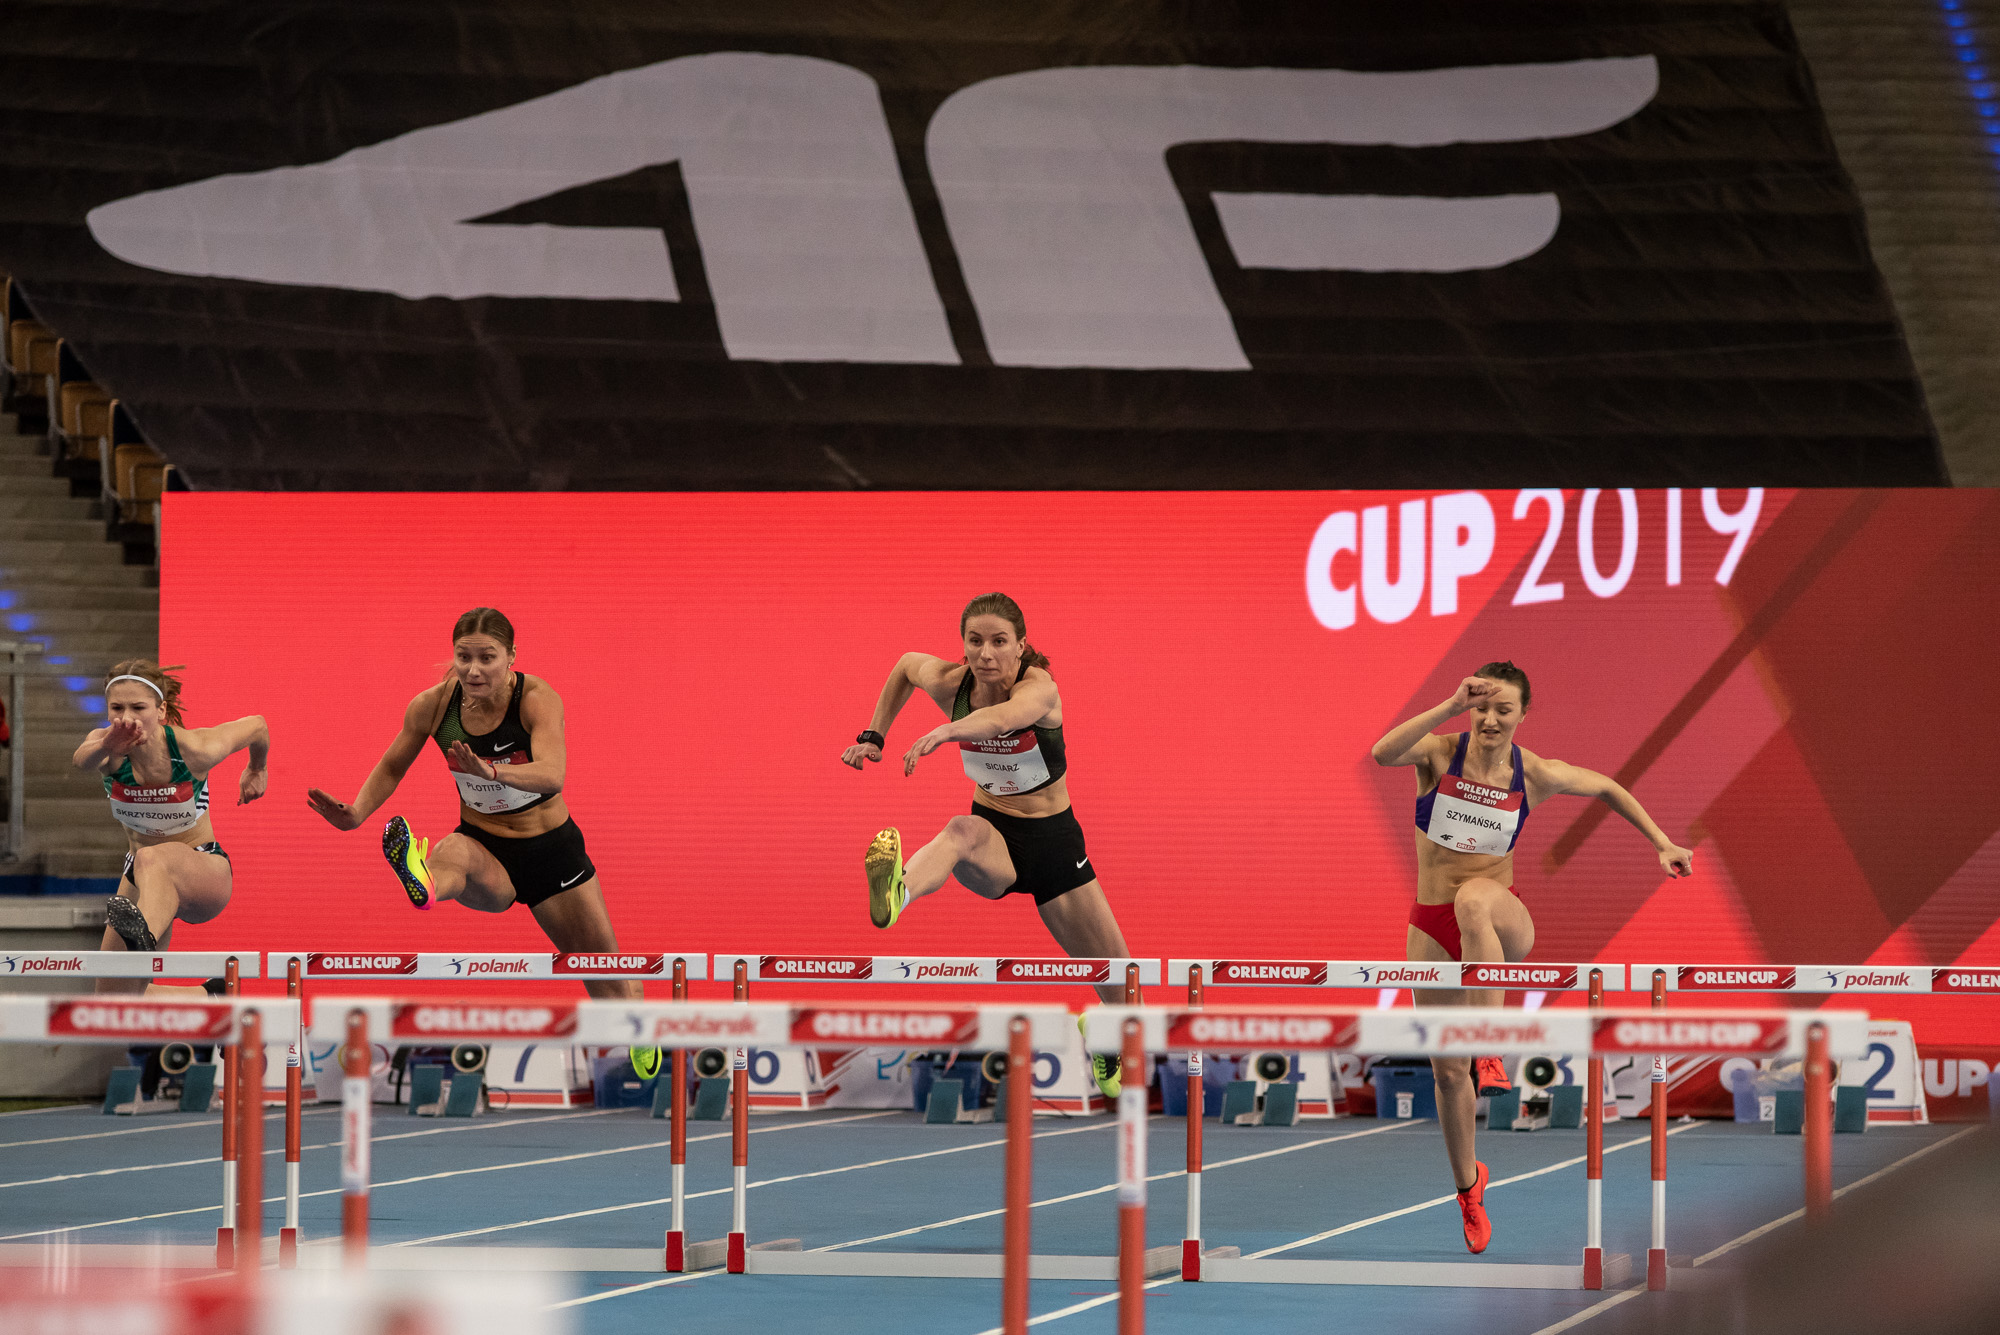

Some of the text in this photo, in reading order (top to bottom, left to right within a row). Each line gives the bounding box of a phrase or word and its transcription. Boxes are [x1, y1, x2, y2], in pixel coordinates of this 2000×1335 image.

[1305, 487, 1764, 630] CUP 2019
[985, 763, 1020, 772] SICIARZ
[124, 786, 177, 797] ORLEN CUP
[1456, 781, 1509, 800] ORLEN CUP
[1482, 797, 1498, 806] 2019
[116, 808, 192, 820] SKRZYSZOWSKA
[1446, 810, 1502, 831] SZYMAŃSKA
[21, 957, 83, 974] polanik
[322, 956, 401, 970] ORLEN CUP
[467, 958, 529, 977] polanik
[567, 956, 647, 969] ORLEN CUP
[775, 960, 856, 974] ORLEN CUP
[916, 962, 979, 980] polanik
[1012, 963, 1093, 977] ORLEN CUP
[1228, 965, 1310, 979] ORLEN CUP
[1376, 966, 1441, 984] polanik
[1477, 968, 1560, 983] ORLEN CUP
[1694, 971, 1778, 984] ORLEN CUP
[1844, 971, 1911, 989] polanik
[1948, 974, 2000, 987] ORLEN
[70, 1006, 208, 1031] ORLEN CUP
[413, 1007, 551, 1032] ORLEN CUP
[812, 1012, 954, 1038] ORLEN CUP
[1190, 1017, 1333, 1043] ORLEN CUP
[1614, 1021, 1762, 1046] ORLEN CUP
[1858, 1043, 1896, 1099] 2
[1919, 1058, 1990, 1098] UP
[1764, 1104, 1773, 1119] 2
